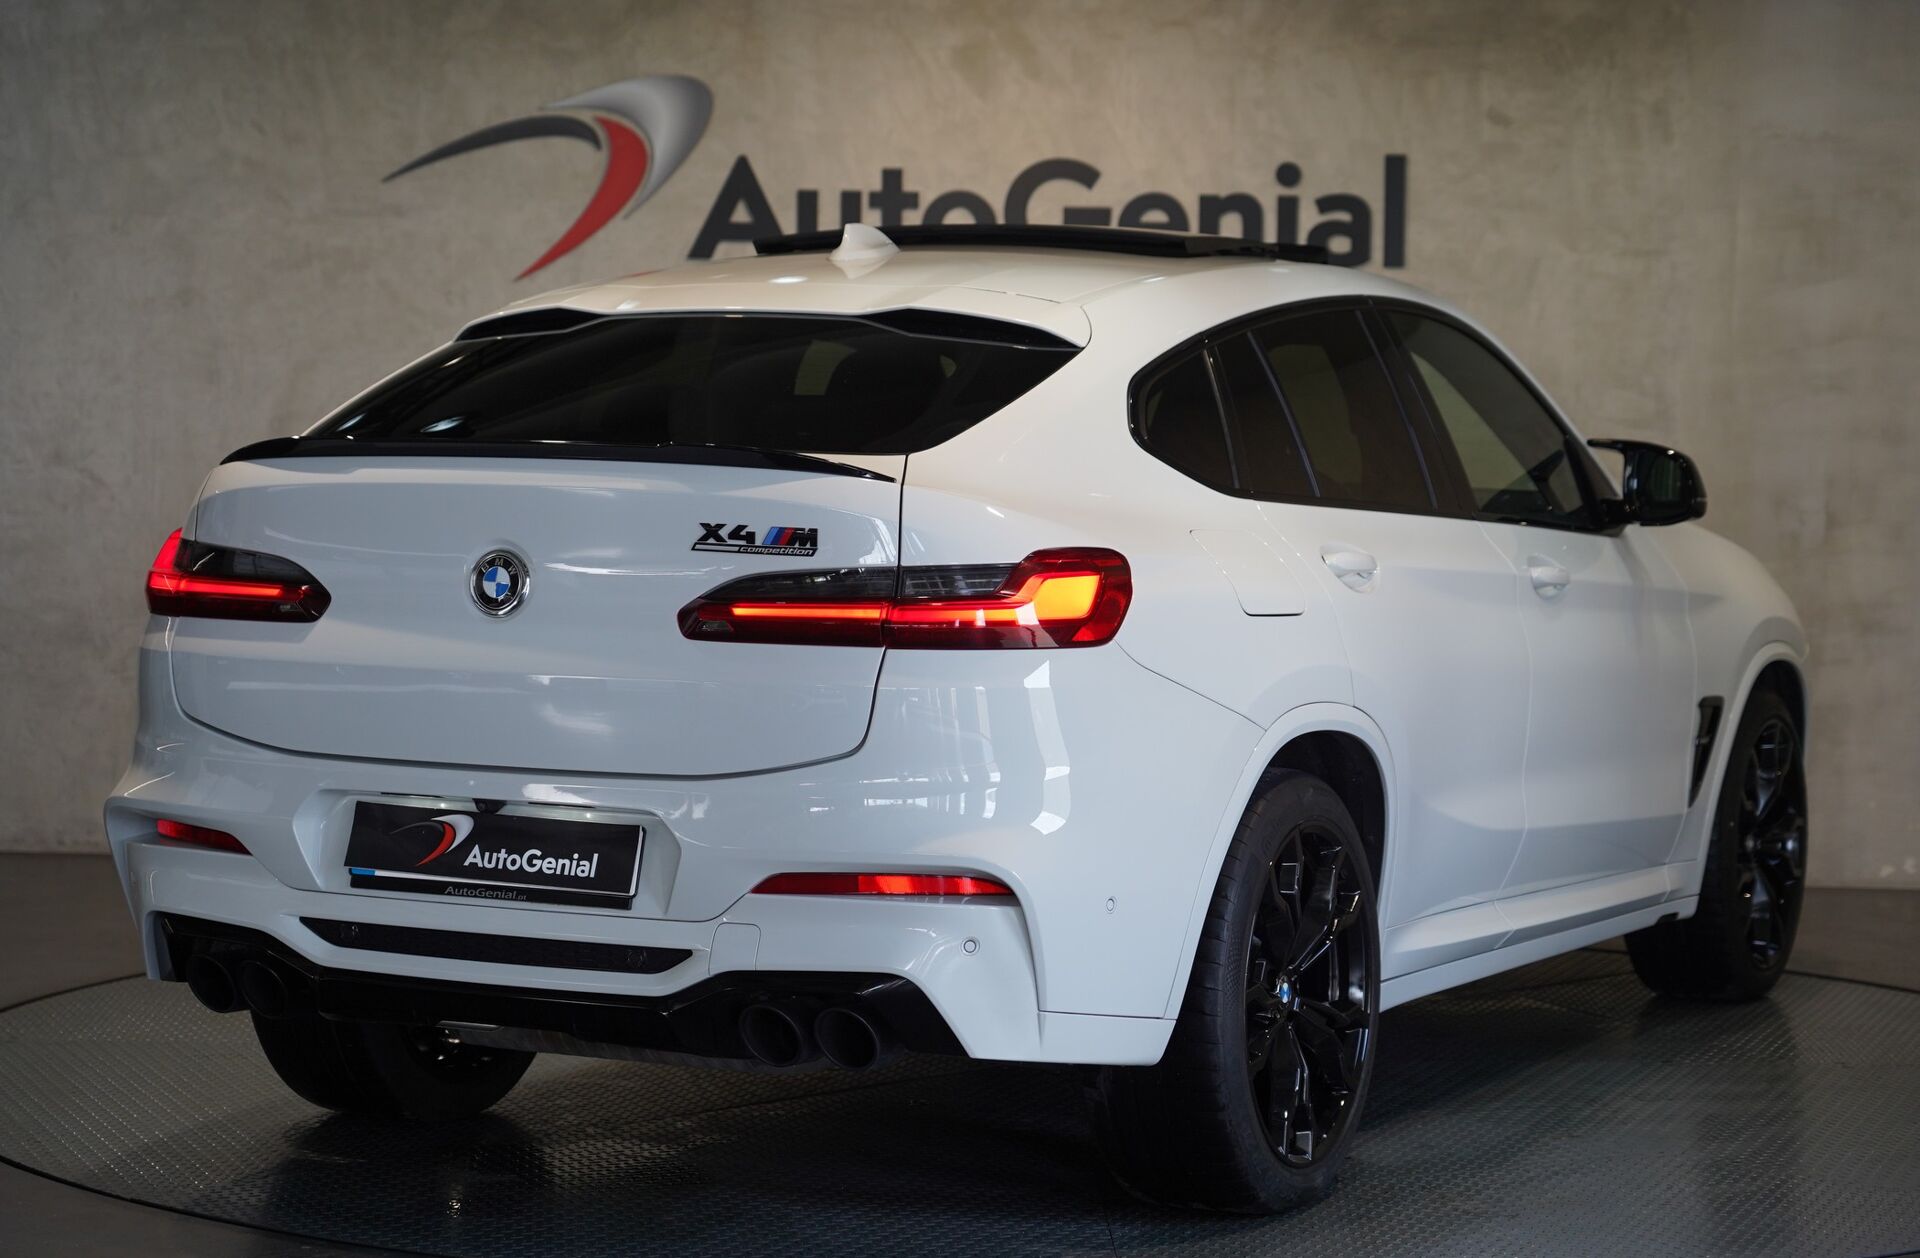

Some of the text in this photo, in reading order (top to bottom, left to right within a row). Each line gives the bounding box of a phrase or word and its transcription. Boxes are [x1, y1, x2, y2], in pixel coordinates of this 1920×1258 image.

[697, 522, 818, 548] X4 M
[740, 545, 814, 556] competition
[463, 844, 599, 878] AutoGenial
[444, 885, 528, 902] AutoGenial.pt
